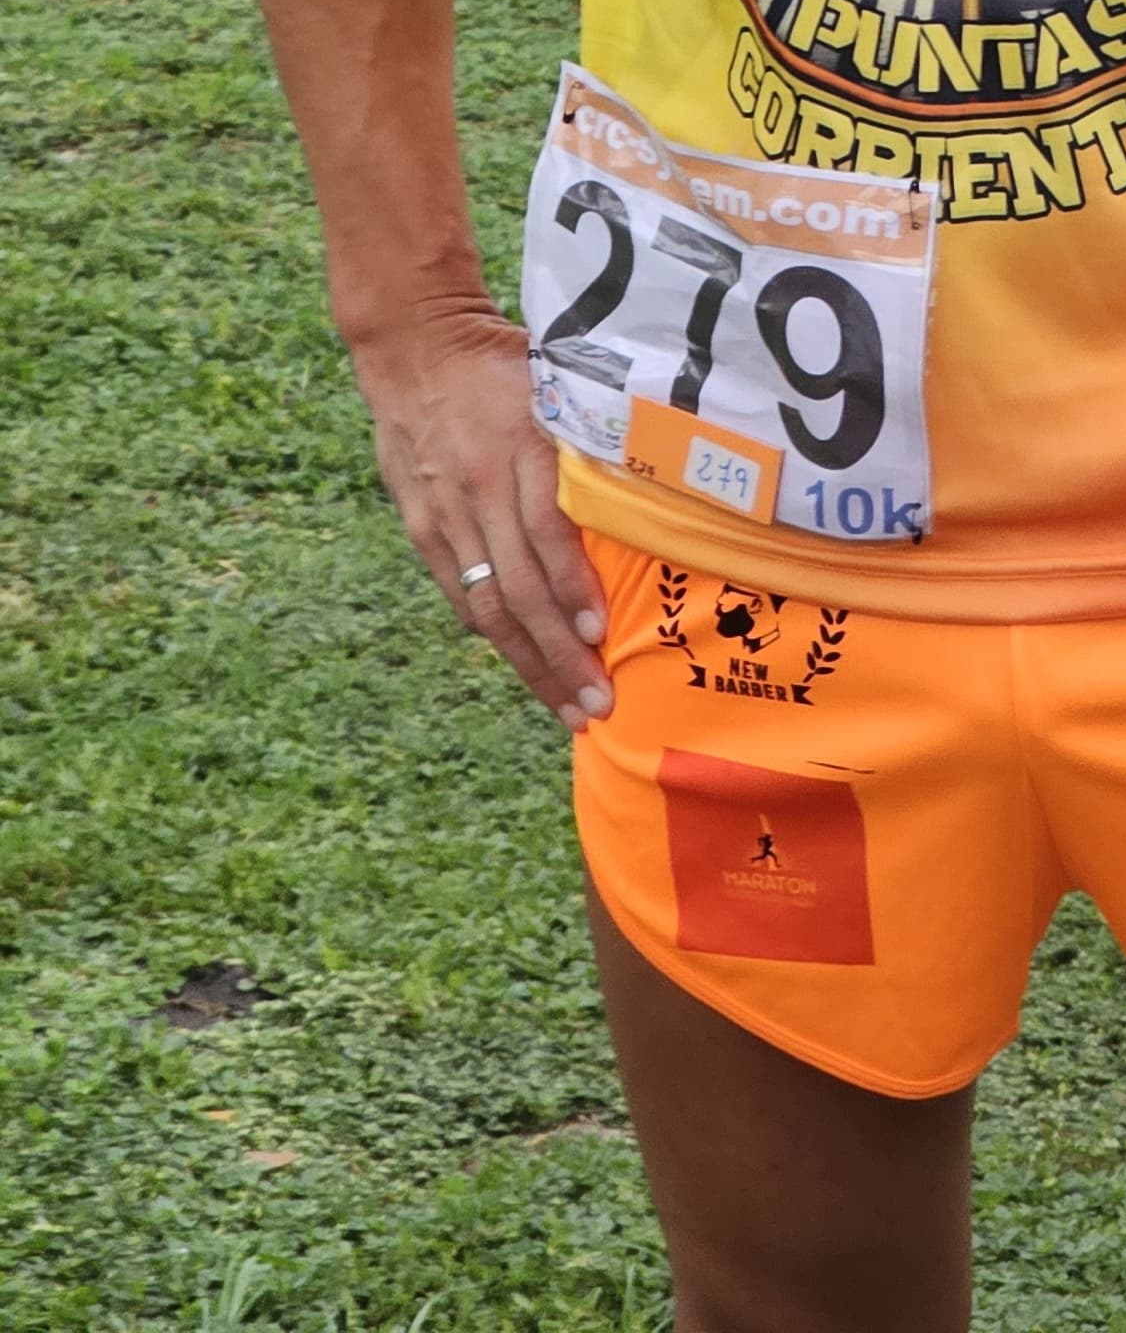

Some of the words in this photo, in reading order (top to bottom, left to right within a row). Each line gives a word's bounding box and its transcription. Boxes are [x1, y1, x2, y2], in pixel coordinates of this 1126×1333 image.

[543, 179, 886, 471] 279
[696, 452, 750, 498] 279
[805, 479, 921, 534] 10k
[729, 657, 769, 681] NEW
[714, 675, 788, 702] BARBER
[721, 871, 817, 895] MARATON
